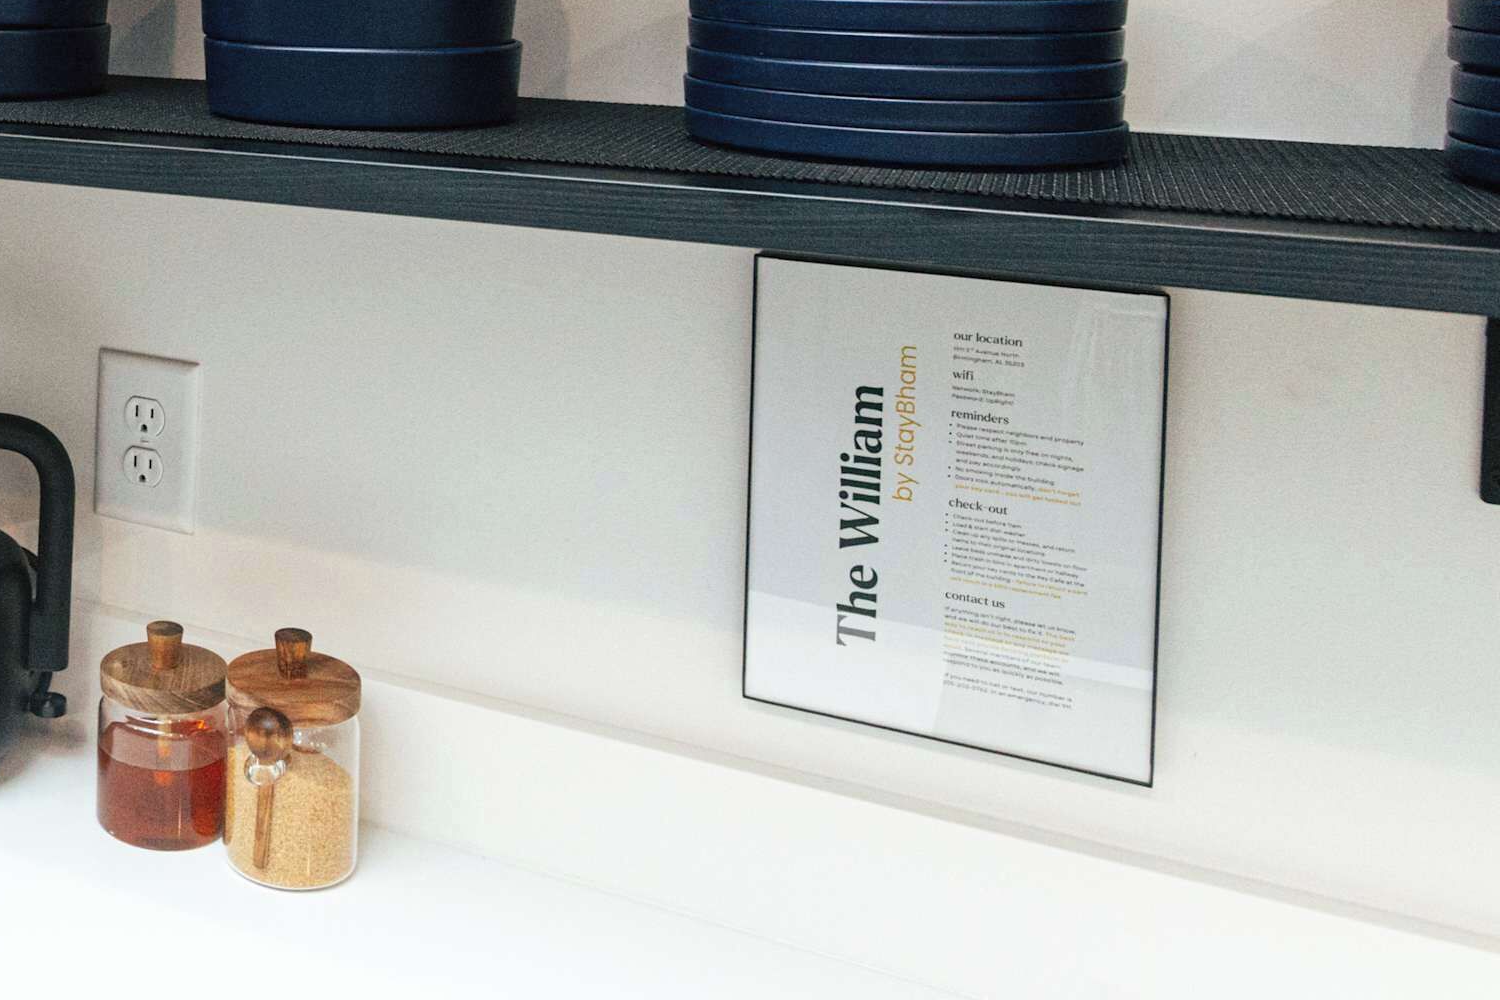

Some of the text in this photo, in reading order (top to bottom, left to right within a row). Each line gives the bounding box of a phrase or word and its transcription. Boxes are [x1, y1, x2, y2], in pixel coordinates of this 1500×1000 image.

[953, 332, 1023, 347] our location
[952, 369, 974, 381] wifi
[892, 344, 921, 502] by StayBham
[950, 409, 1010, 425] reminders
[1054, 437, 1083, 447] property
[948, 498, 1008, 516] check-out
[836, 384, 884, 647] The William
[944, 592, 1006, 609] contact us
